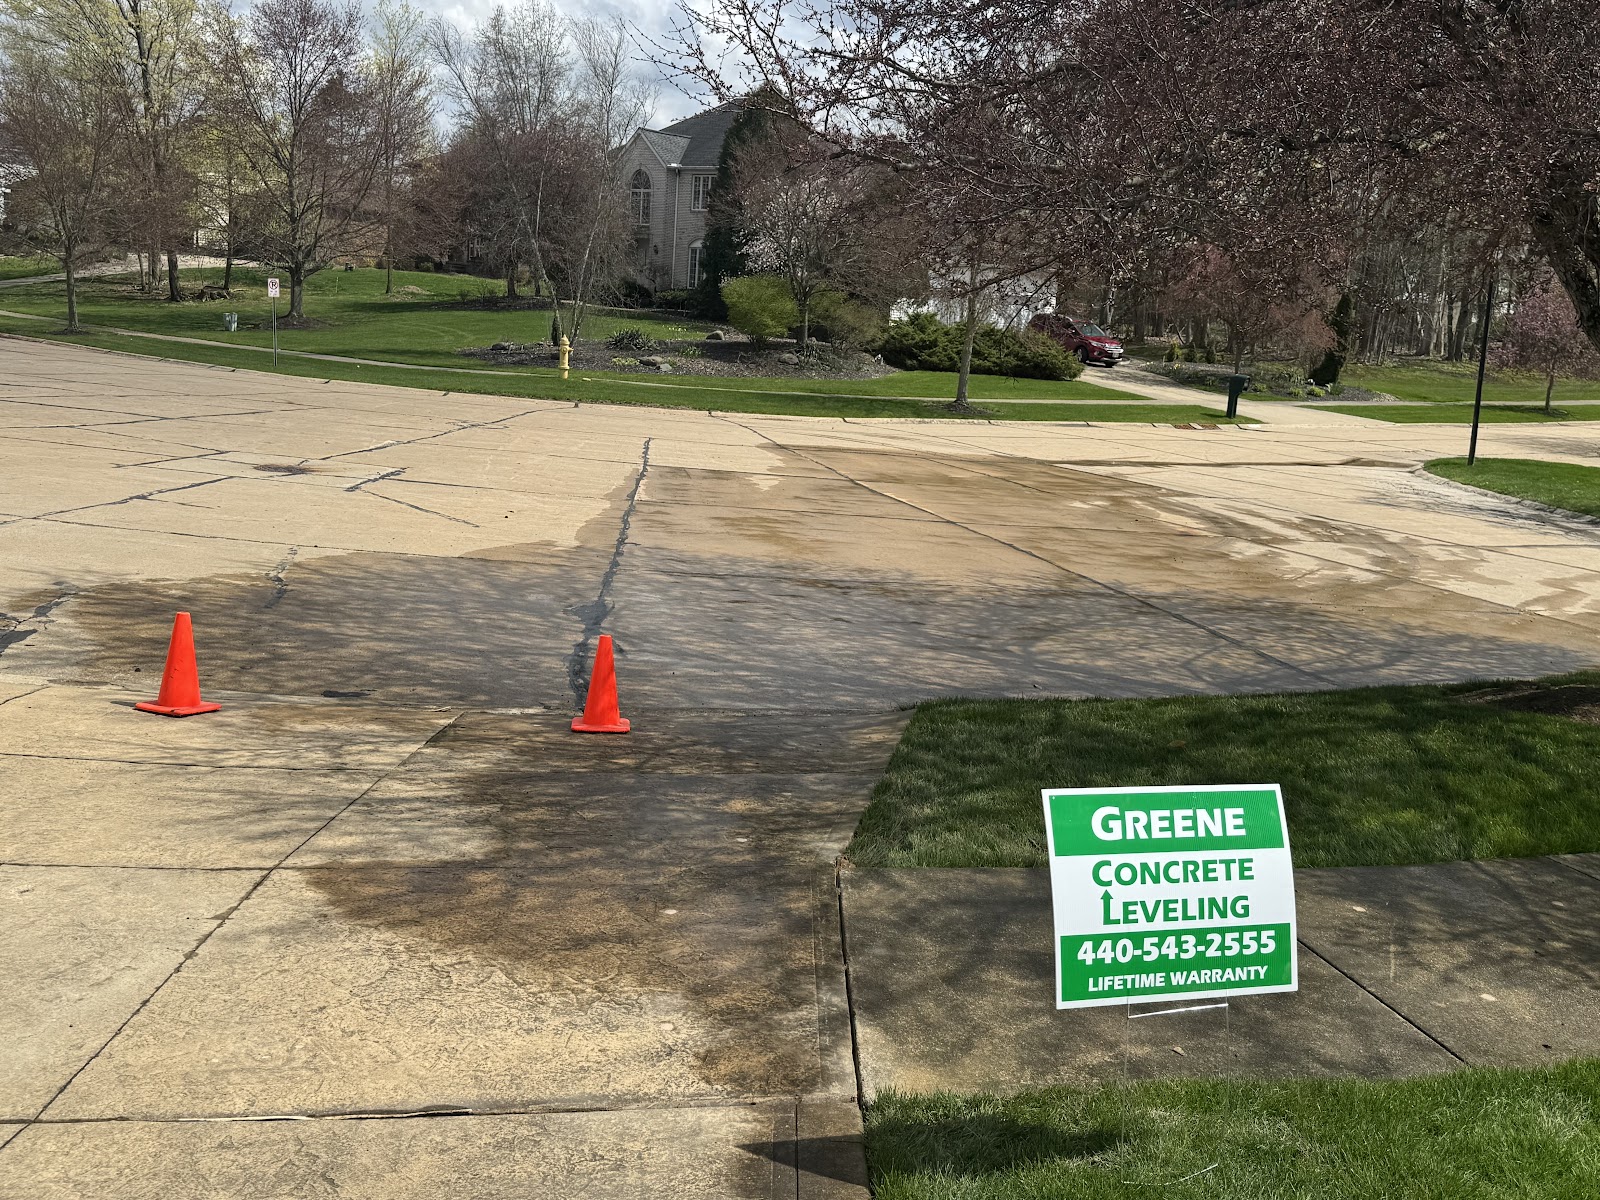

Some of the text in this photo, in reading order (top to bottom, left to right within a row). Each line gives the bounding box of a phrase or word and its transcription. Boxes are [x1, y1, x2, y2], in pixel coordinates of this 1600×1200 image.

[1091, 806, 1247, 841] GREENE
[1092, 858, 1255, 887] CONCRETE
[1102, 894, 1250, 925] LEVELING
[1077, 930, 1276, 966] 440-543-2555
[1088, 965, 1269, 992] LIFETIME WARRANTY
